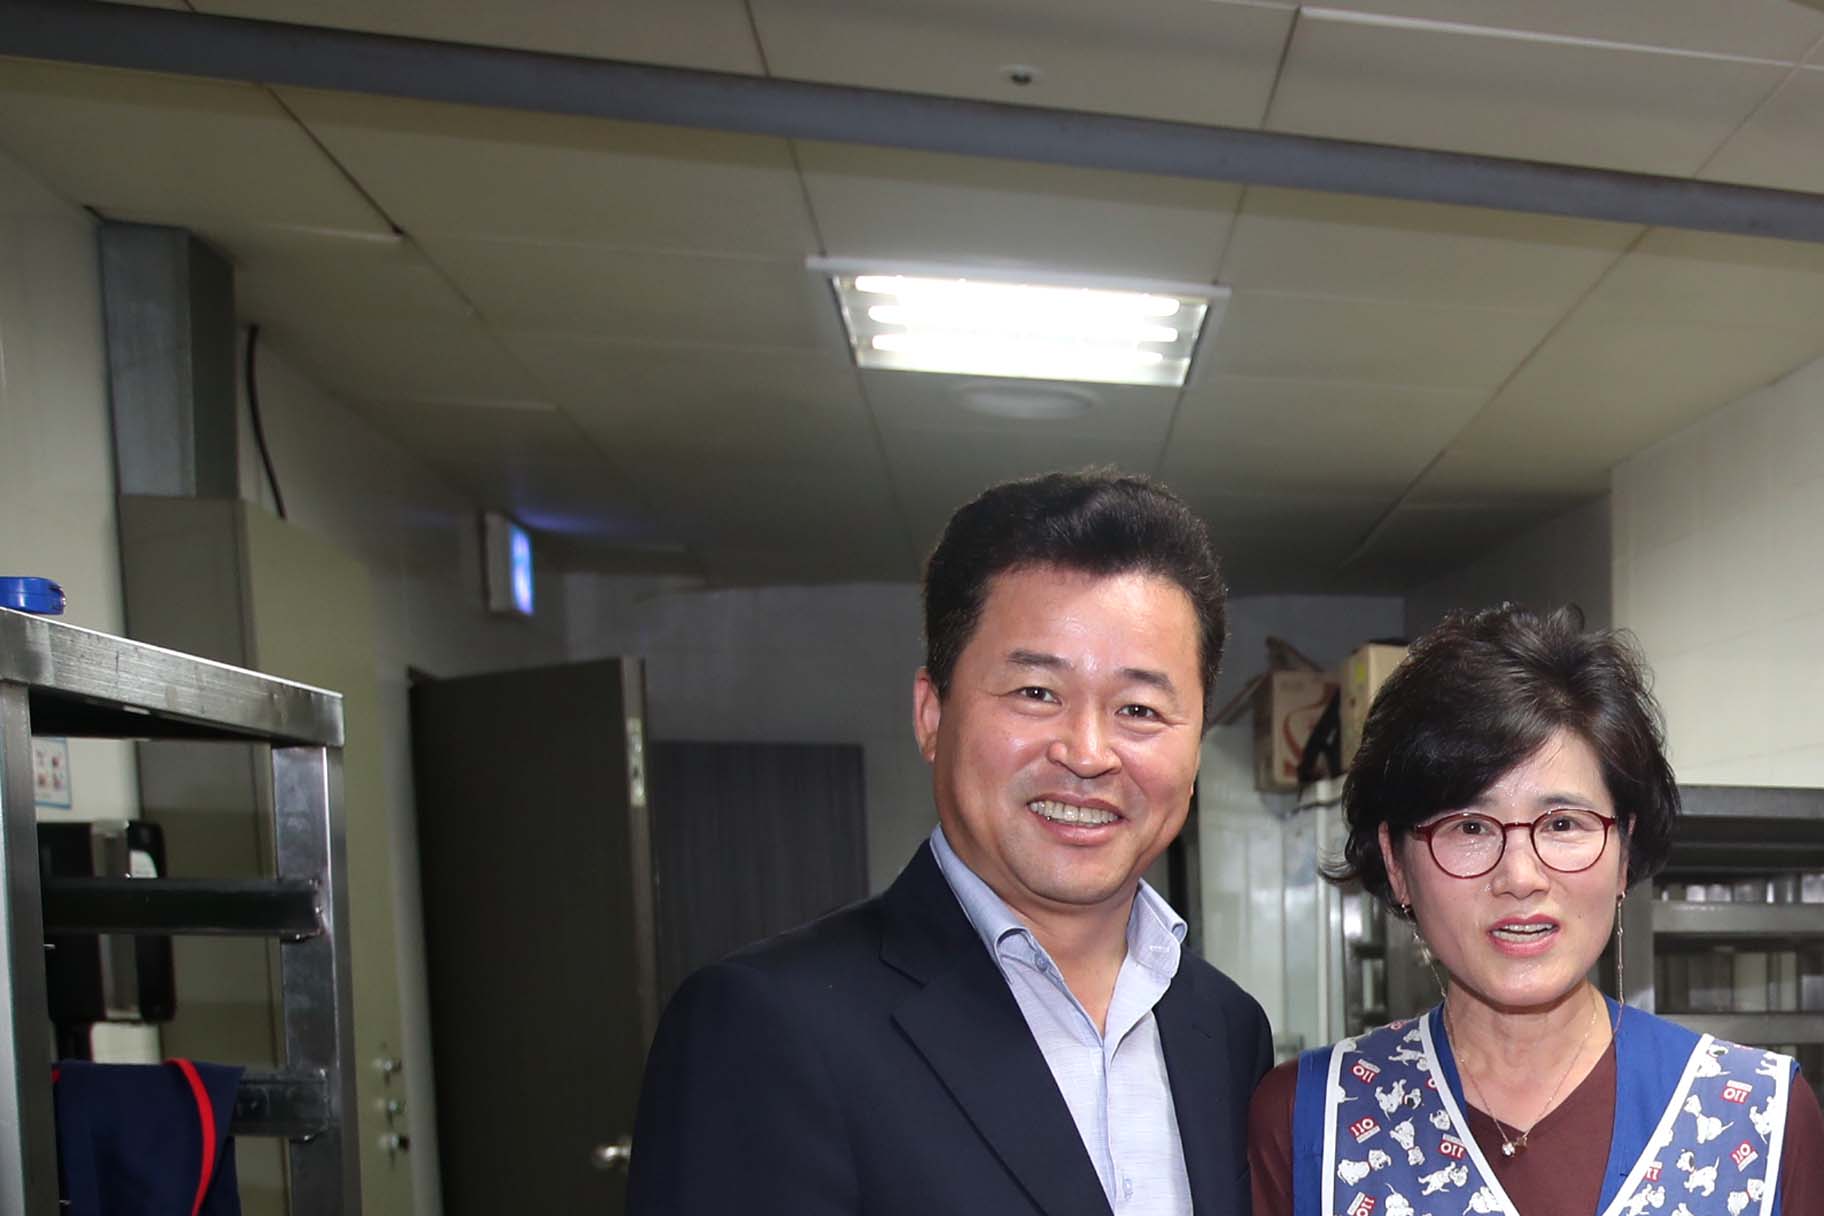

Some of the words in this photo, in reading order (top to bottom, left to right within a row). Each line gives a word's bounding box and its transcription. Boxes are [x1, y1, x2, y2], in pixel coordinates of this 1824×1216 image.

[1353, 1065, 1375, 1083] 110
[1724, 1090, 1747, 1103] 110
[1351, 1118, 1374, 1136] 110
[1440, 1142, 1463, 1159] 110
[1733, 1144, 1750, 1163] 110
[1644, 1169, 1658, 1180] 11
